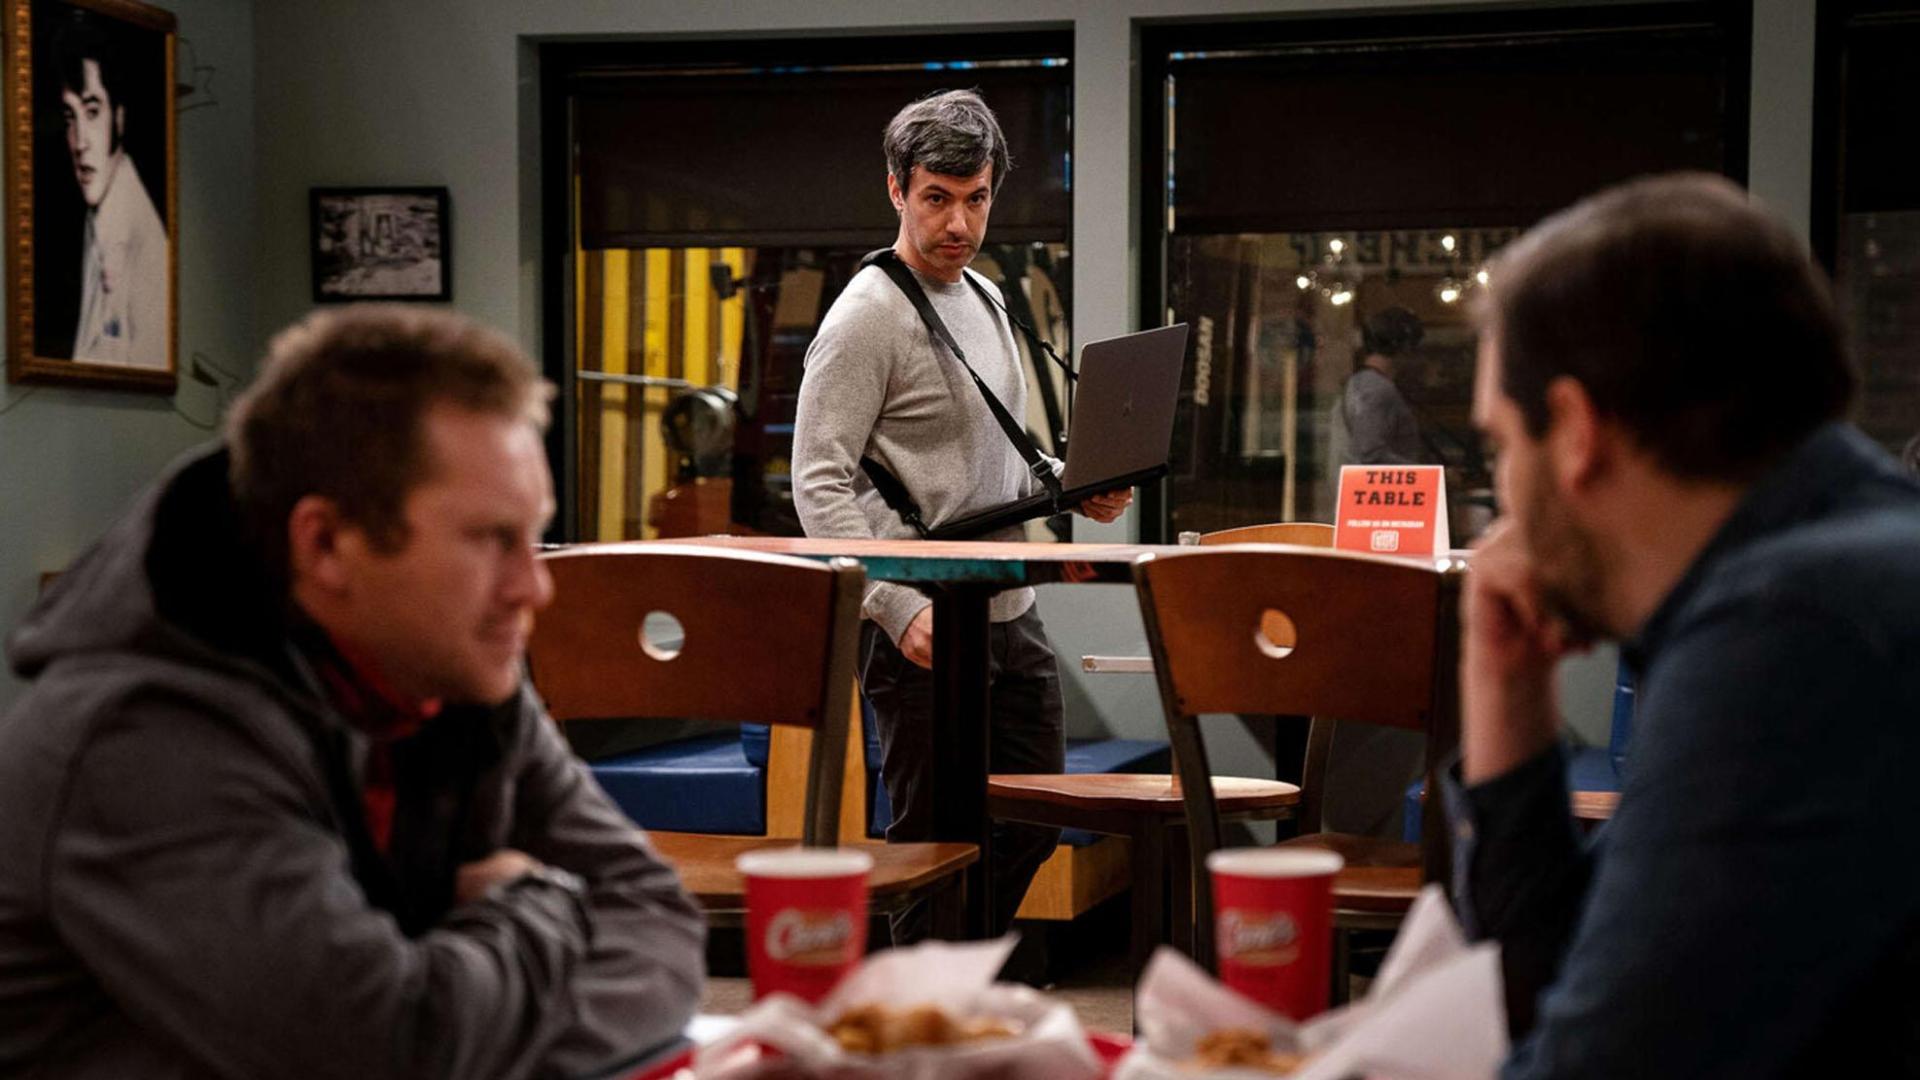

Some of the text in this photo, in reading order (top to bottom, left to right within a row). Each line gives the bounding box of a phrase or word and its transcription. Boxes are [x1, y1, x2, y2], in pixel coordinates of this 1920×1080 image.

[1194, 315, 1214, 405] DOOSAN
[1366, 471, 1417, 484] THIS
[1354, 491, 1425, 506] TABLE
